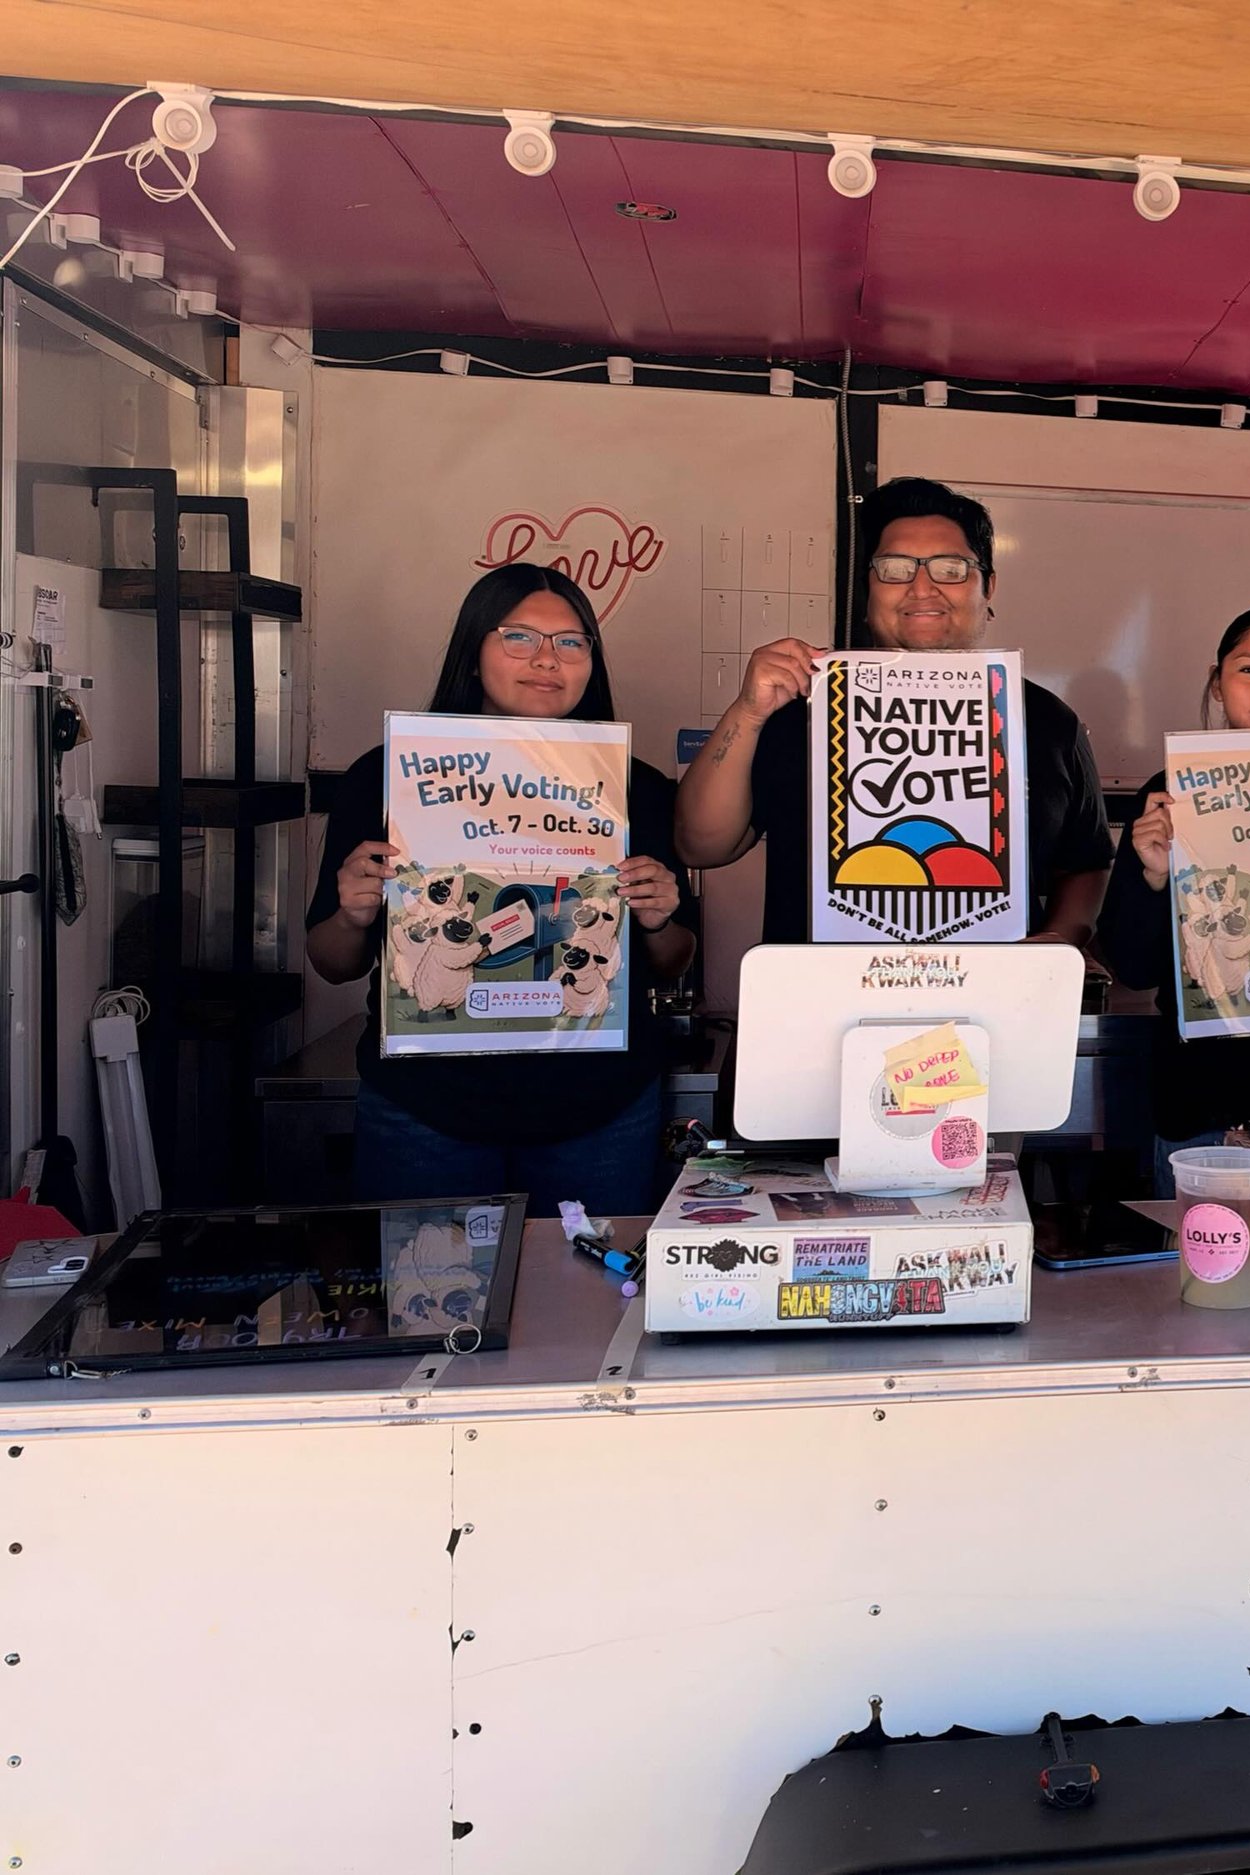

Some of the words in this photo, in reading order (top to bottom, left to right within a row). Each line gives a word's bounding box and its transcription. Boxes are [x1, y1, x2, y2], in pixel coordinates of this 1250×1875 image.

[887, 669, 982, 680] ARIZONA
[854, 696, 983, 725] NATIVE
[856, 726, 983, 756] YOUTH
[399, 751, 491, 778] Happy
[416, 774, 495, 806] Early
[502, 774, 603, 810] Voting!
[463, 821, 504, 839] Oct.
[508, 815, 521, 832] 7
[543, 814, 582, 833] Oct.
[588, 818, 614, 837] 30
[489, 845, 518, 855] Your
[522, 846, 553, 855] voice
[556, 846, 595, 856] counts
[828, 898, 867, 922] DON'T
[868, 919, 884, 930] BE
[885, 928, 907, 942] ALL
[975, 901, 1011, 922] VOTE!
[492, 992, 561, 1001] ARIZONA
[1187, 1229, 1241, 1244] LOLLY'S
[795, 1243, 867, 1254] REMATRIATE
[797, 1257, 822, 1266] THE
[829, 1256, 866, 1266] LAND
